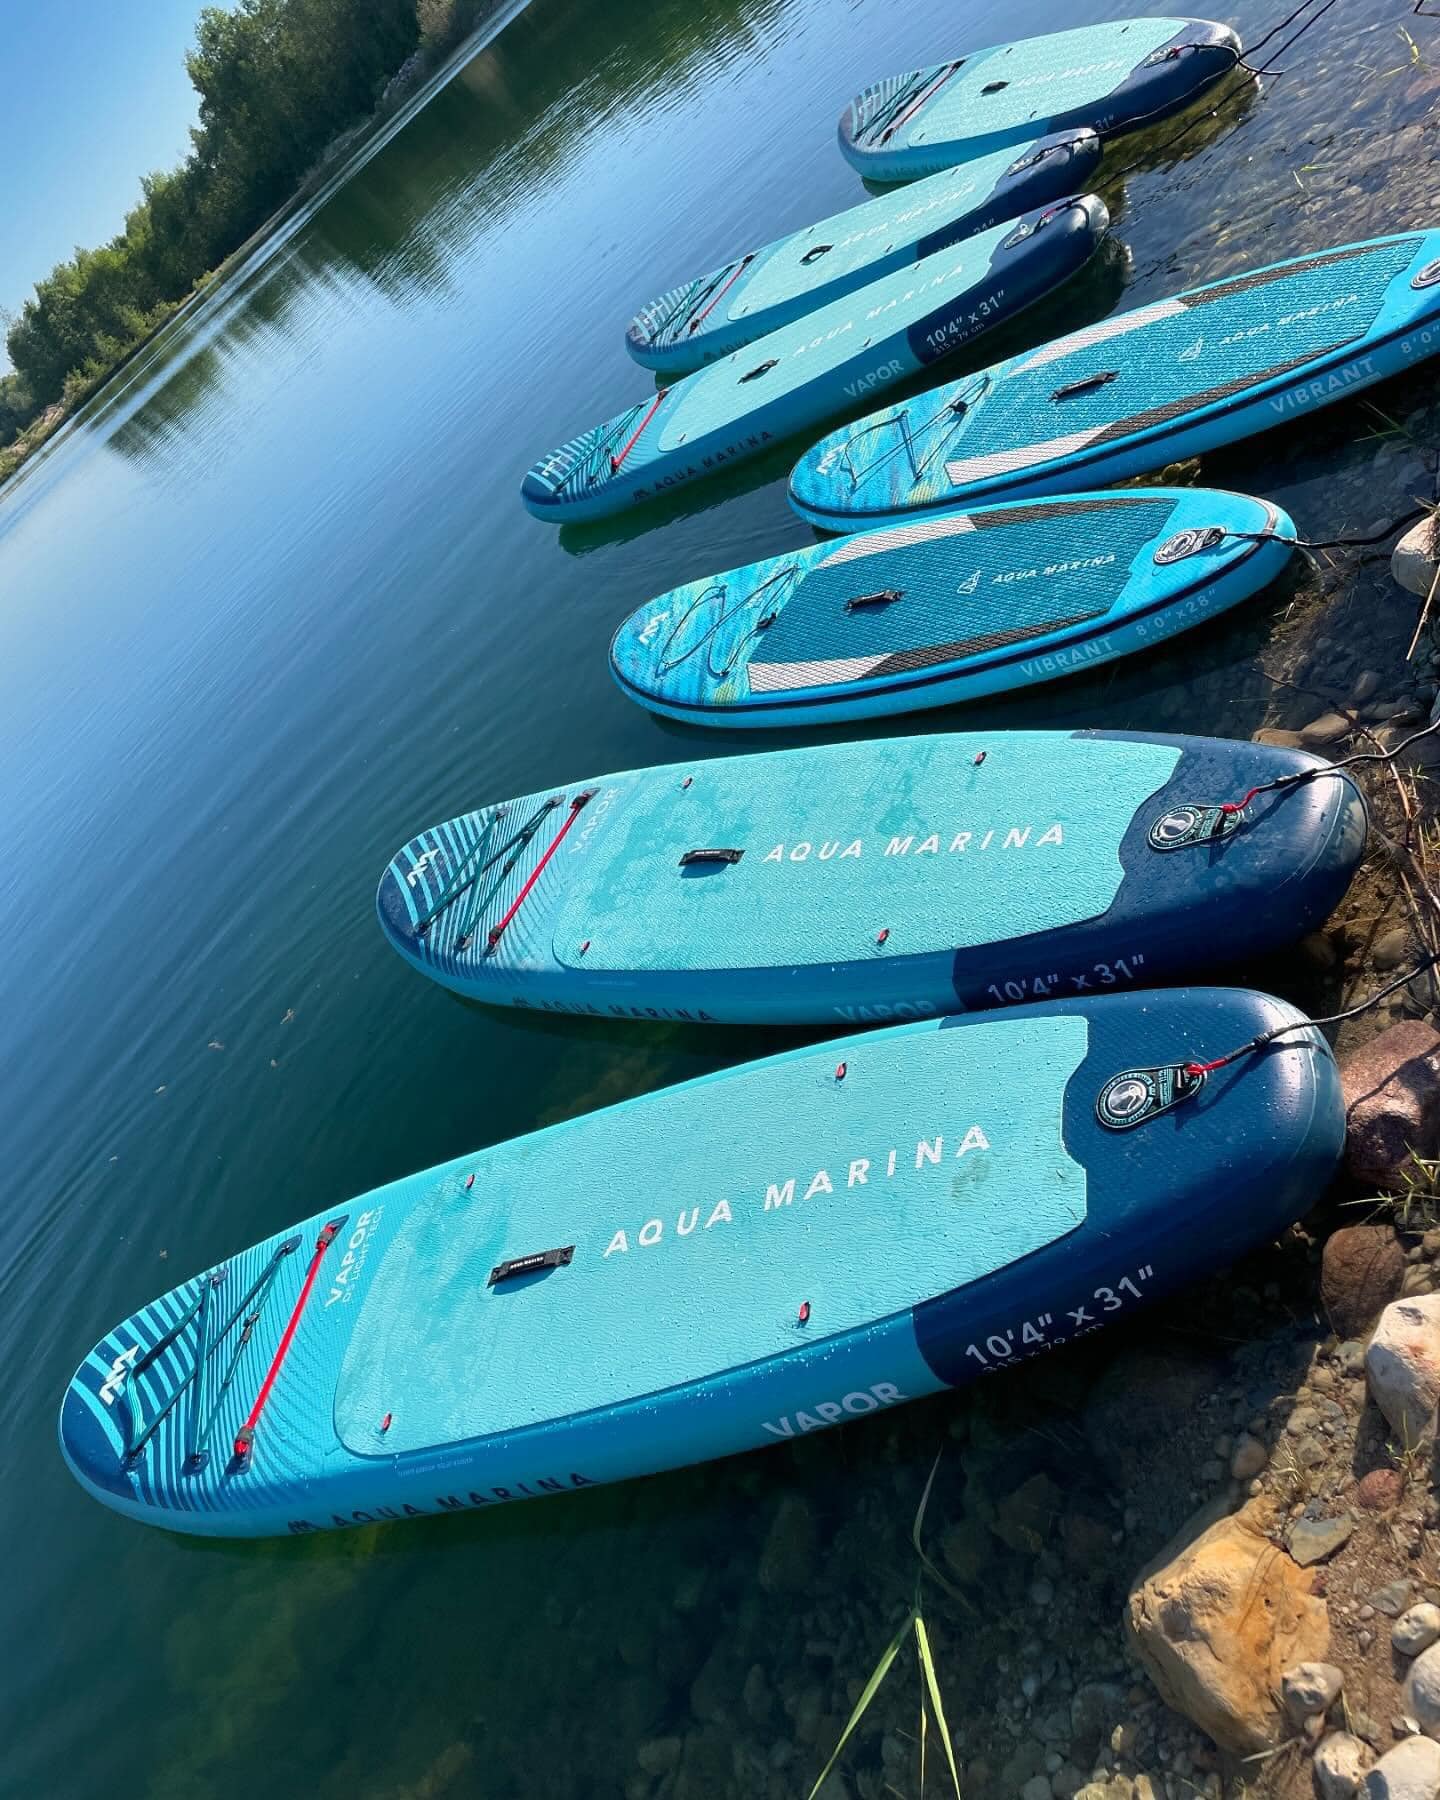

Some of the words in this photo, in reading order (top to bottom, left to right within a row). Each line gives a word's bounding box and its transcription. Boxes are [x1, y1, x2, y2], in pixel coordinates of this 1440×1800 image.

[792, 320, 852, 357] AQUA
[865, 265, 962, 320] MARINA
[926, 316, 963, 346] 10'4"
[979, 290, 1004, 315] 31"
[843, 359, 905, 397] VAPOR
[1269, 357, 1378, 413] VIBRANT
[653, 466, 697, 491] AQUA
[702, 431, 773, 468] MARINA
[991, 569, 1038, 584] AQUA
[1042, 554, 1116, 576] MARINA
[1020, 636, 1114, 678] VIBRANT
[568, 789, 618, 855] VAPOR
[762, 839, 863, 863] AQUA
[884, 824, 1064, 857] MARINA
[988, 973, 1059, 1002] 10'4"
[1093, 954, 1145, 985] 31"
[607, 1004, 719, 1022] MARINA
[603, 1199, 733, 1259] AQUA
[763, 1125, 991, 1212] MARINA
[324, 1210, 375, 1308] VAPOR
[965, 1313, 1053, 1364] 10'4"
[1066, 1306, 1095, 1327] x
[1093, 1264, 1154, 1311] 31"
[761, 1382, 909, 1437] VAPOR
[331, 1503, 427, 1527] AQUA
[436, 1472, 594, 1510] MARINA
